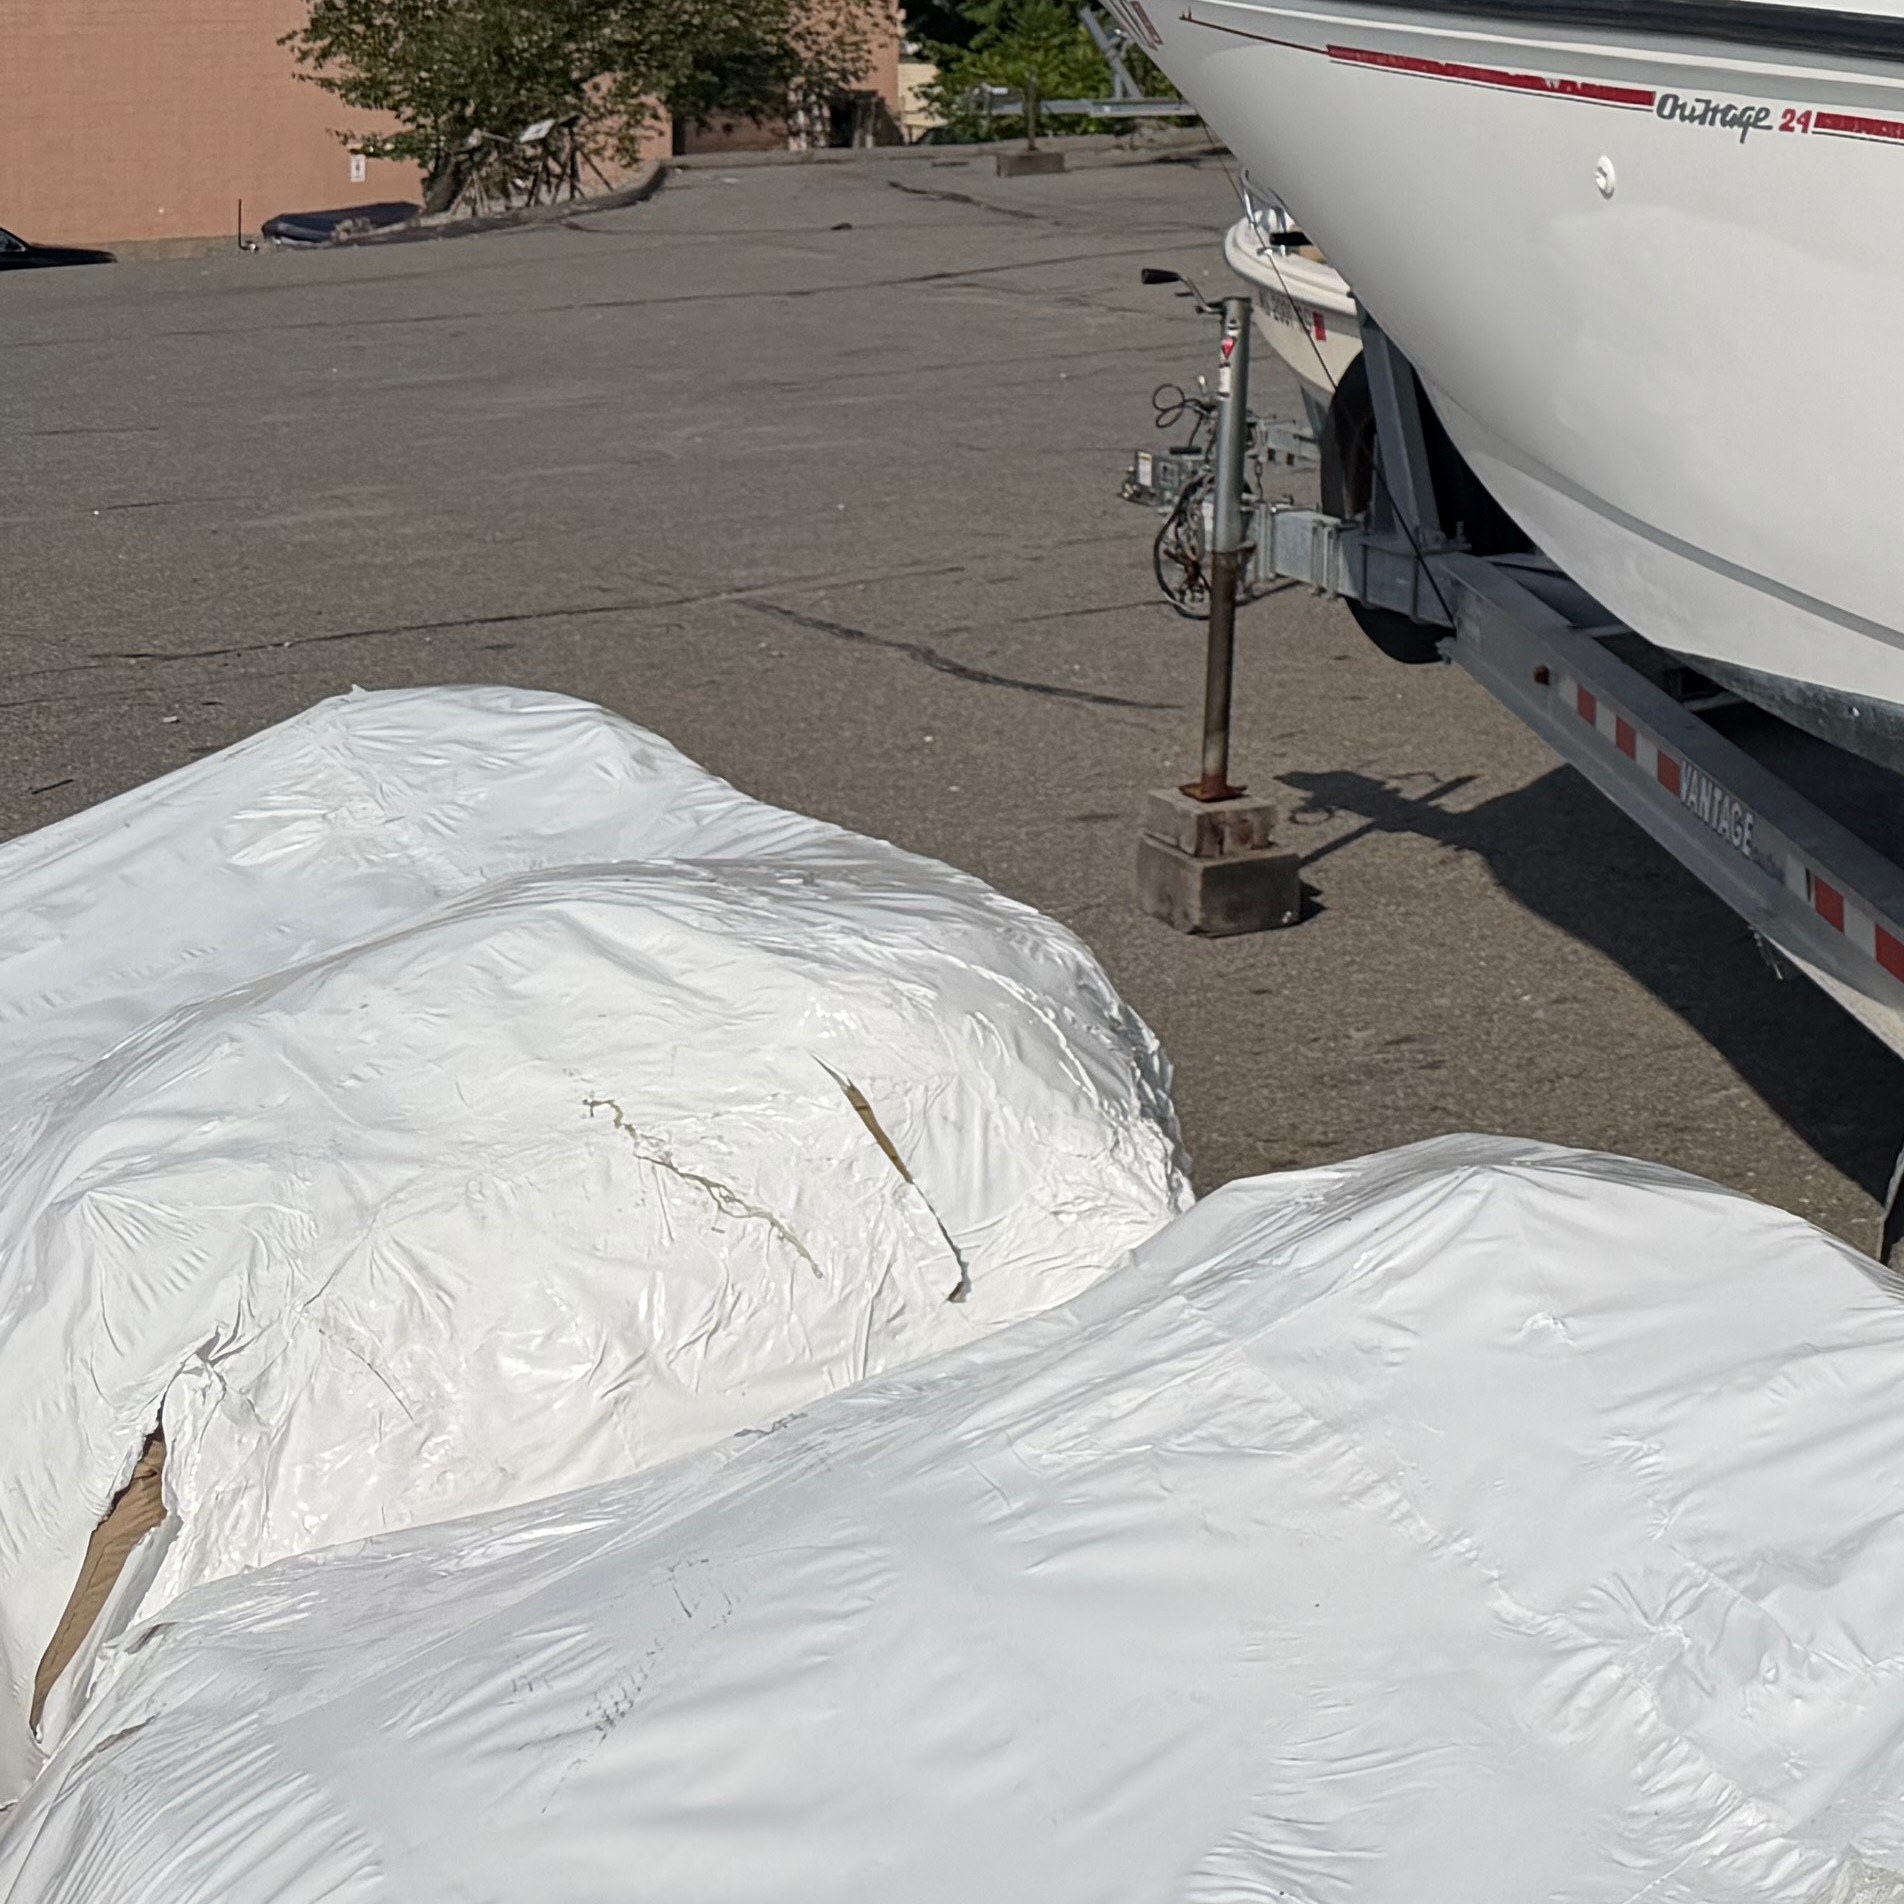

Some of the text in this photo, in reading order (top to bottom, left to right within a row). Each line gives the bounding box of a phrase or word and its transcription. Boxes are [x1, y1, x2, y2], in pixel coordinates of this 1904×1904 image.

[1656, 92, 1813, 145] Outrage 24
[1680, 760, 1754, 858] VANTAGE
